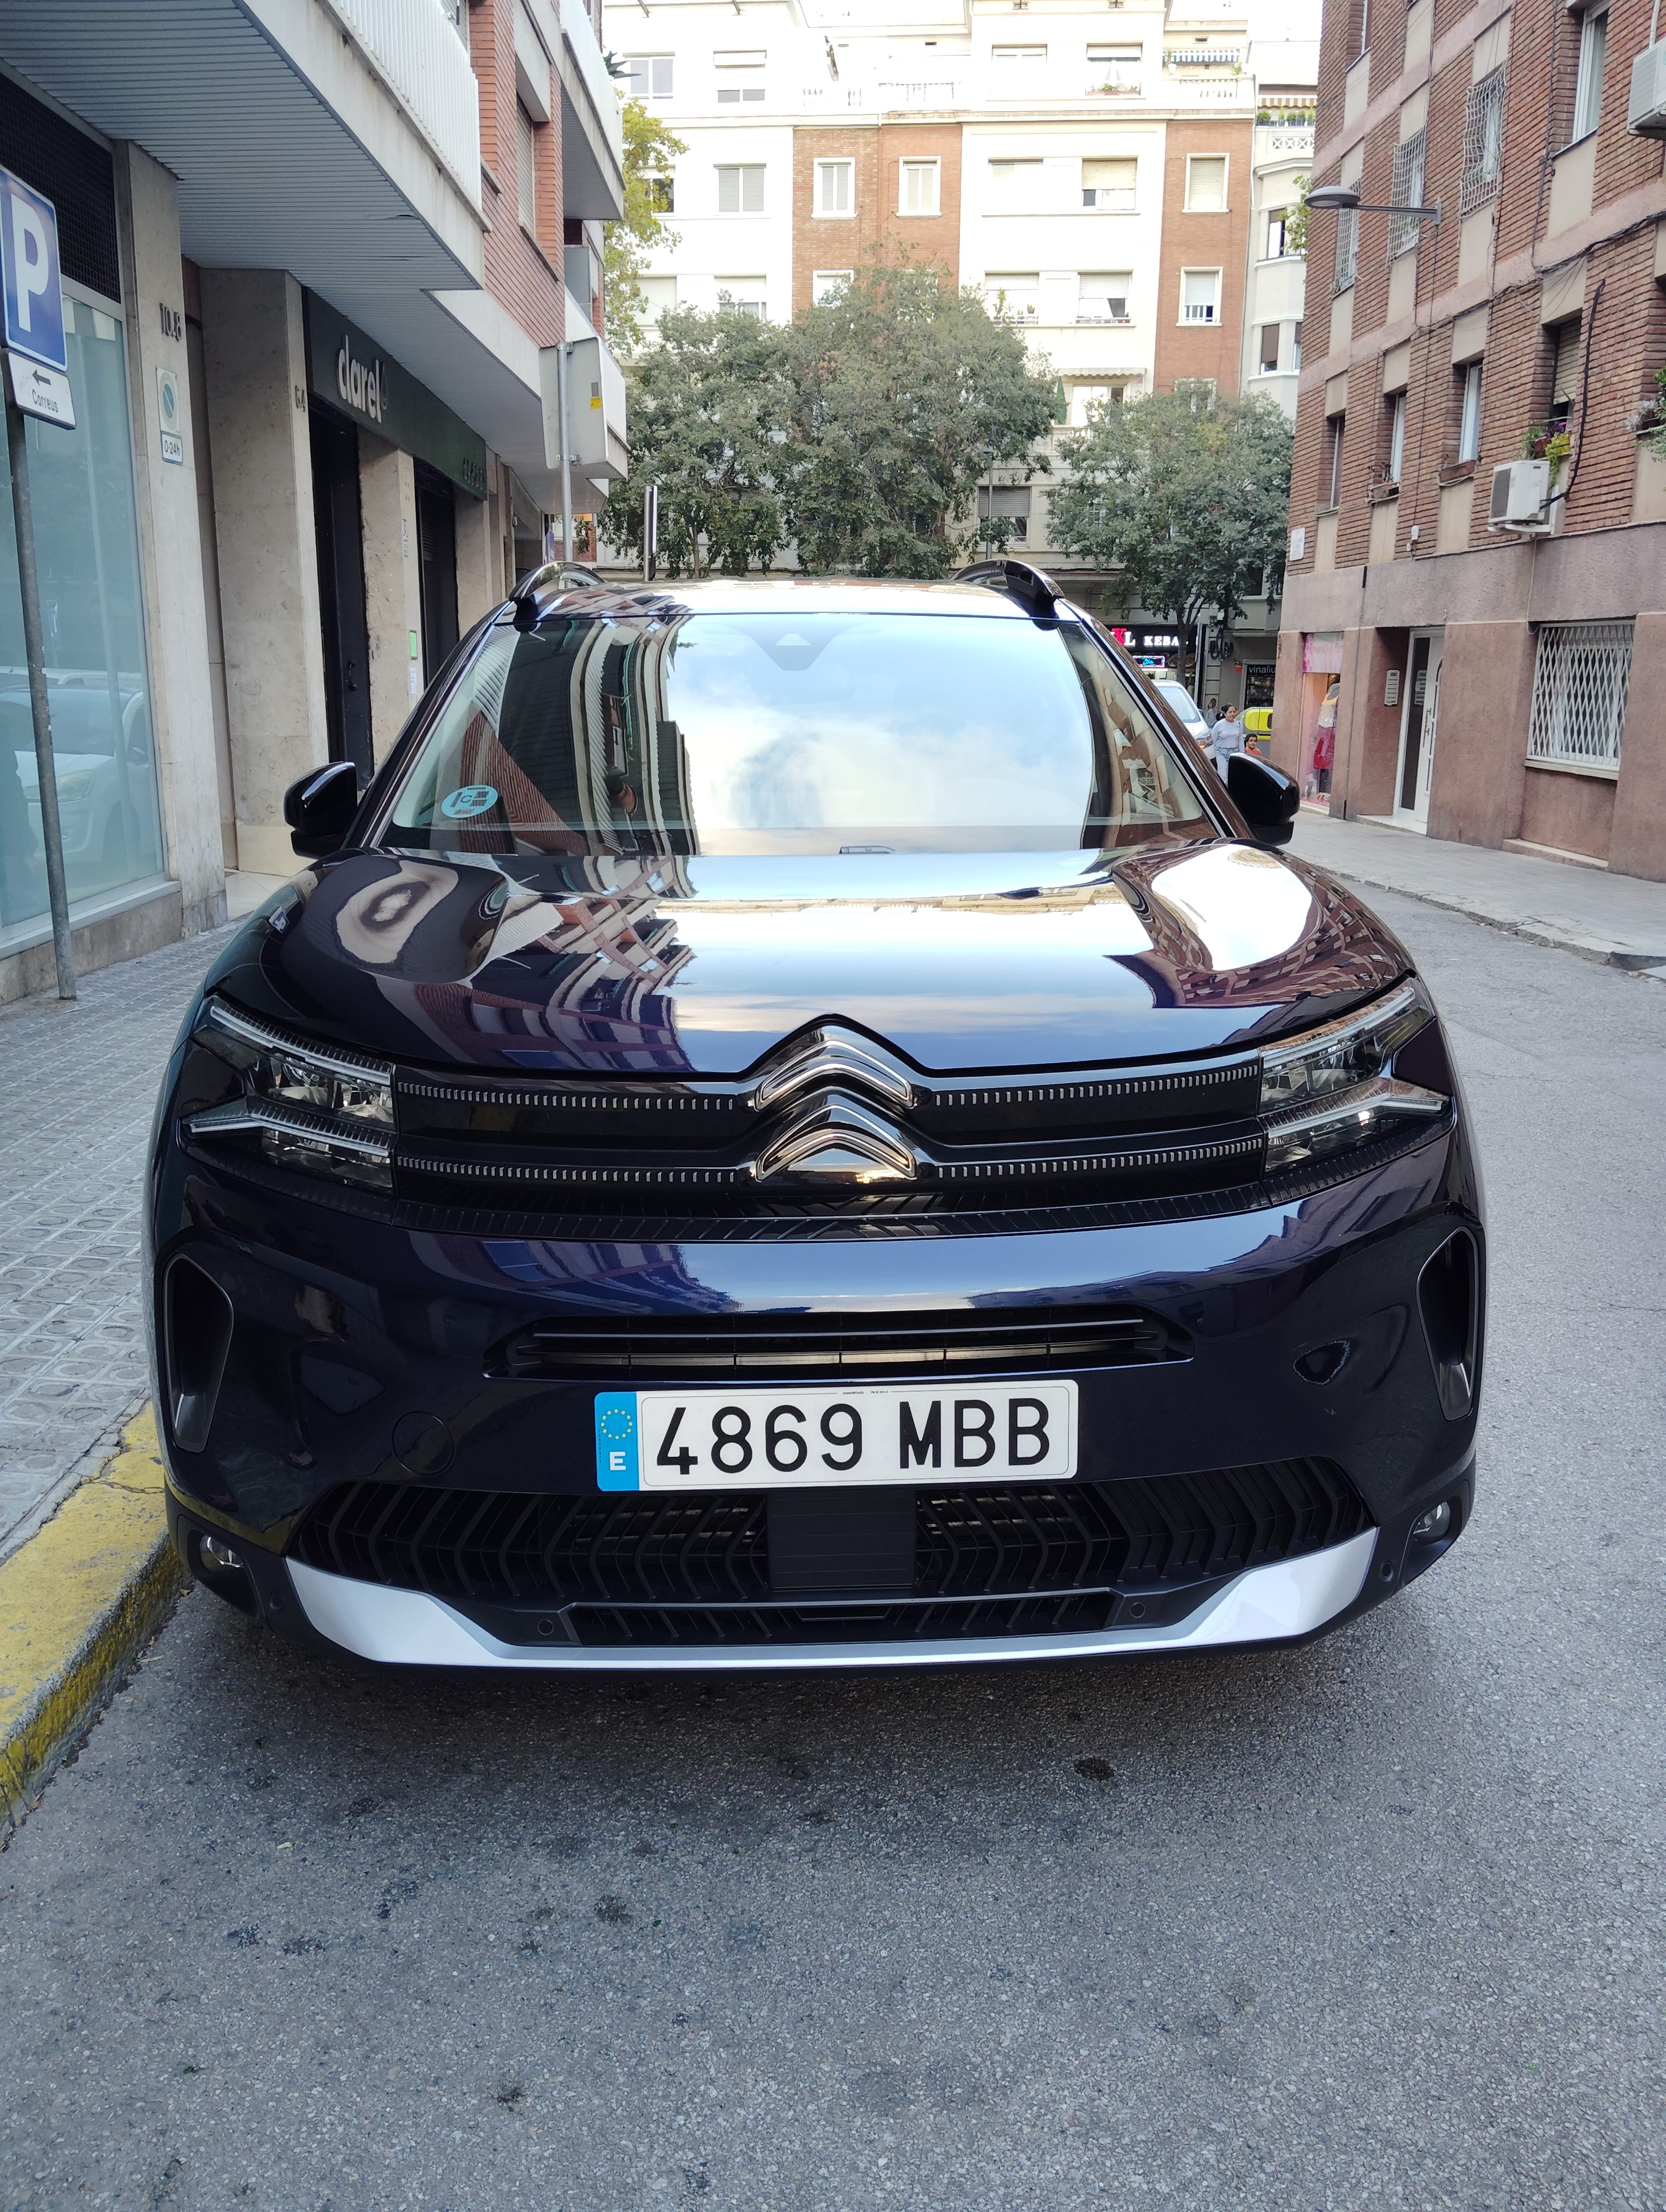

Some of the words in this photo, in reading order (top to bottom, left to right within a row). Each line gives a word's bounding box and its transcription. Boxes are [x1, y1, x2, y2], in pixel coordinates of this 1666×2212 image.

[11, 193, 49, 332] P
[338, 335, 382, 423] clarel
[32, 388, 59, 413] Correus
[164, 440, 181, 456] 0-24h
[1144, 635, 1189, 647] KEBA
[1249, 665, 1276, 673] vinaliu
[460, 795, 472, 803] C
[656, 1403, 863, 1475] 4869
[899, 1398, 1050, 1468] MBB
[609, 1451, 626, 1471] E
